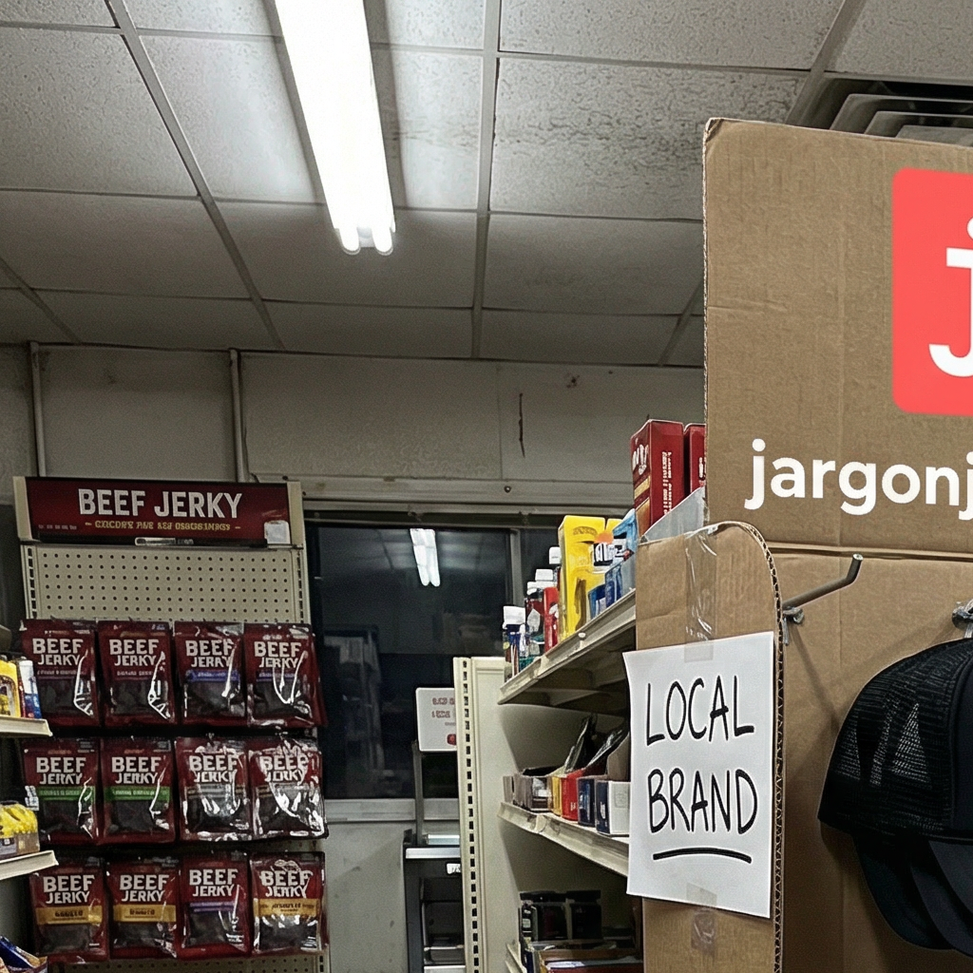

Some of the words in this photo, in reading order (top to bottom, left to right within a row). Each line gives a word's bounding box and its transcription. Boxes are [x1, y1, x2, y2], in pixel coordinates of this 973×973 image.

[78, 488, 146, 516] BEEF
[154, 491, 243, 519] JERKY
[32, 638, 84, 655] BEEF
[109, 639, 160, 656] BEEF
[185, 639, 236, 657] BEEF
[254, 641, 302, 657] BEEF
[37, 654, 81, 666] JERKY
[114, 655, 157, 667] JERKY
[646, 675, 755, 747] LOCAL
[36, 757, 87, 773] BEEF
[111, 756, 162, 772] BEEF
[189, 755, 238, 771] BEEF
[647, 767, 758, 835] BRAND
[43, 874, 95, 893] BEEF
[120, 874, 169, 890] BEEF
[189, 868, 239, 886] BEEF
[260, 869, 314, 887] BEEF
[46, 891, 90, 905] JERKY
[121, 890, 166, 902] JERKY
[192, 884, 235, 897] JERKY
